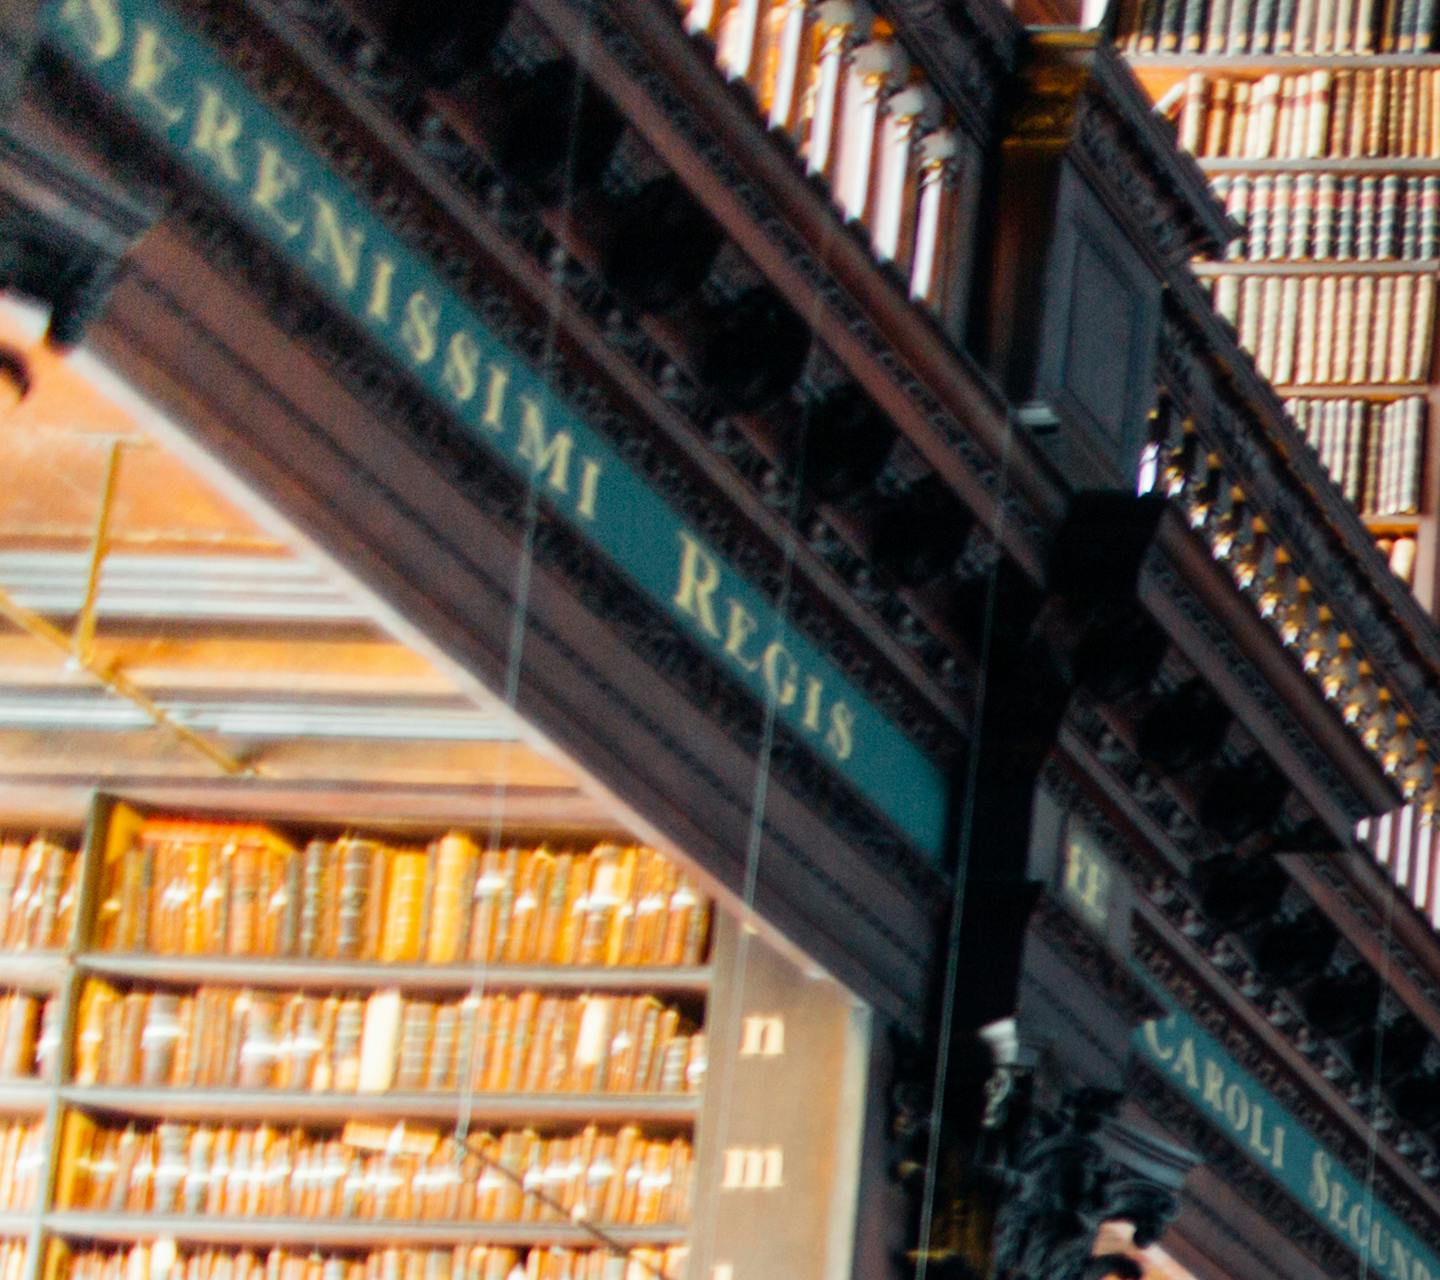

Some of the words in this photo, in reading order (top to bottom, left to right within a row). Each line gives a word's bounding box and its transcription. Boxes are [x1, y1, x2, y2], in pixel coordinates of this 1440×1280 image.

[58, 0, 602, 520] SERENISSIMI
[672, 530, 862, 764] REGIS
[741, 1015, 785, 1055] n
[1143, 1016, 1285, 1172] CAROLI
[722, 1147, 784, 1188] m
